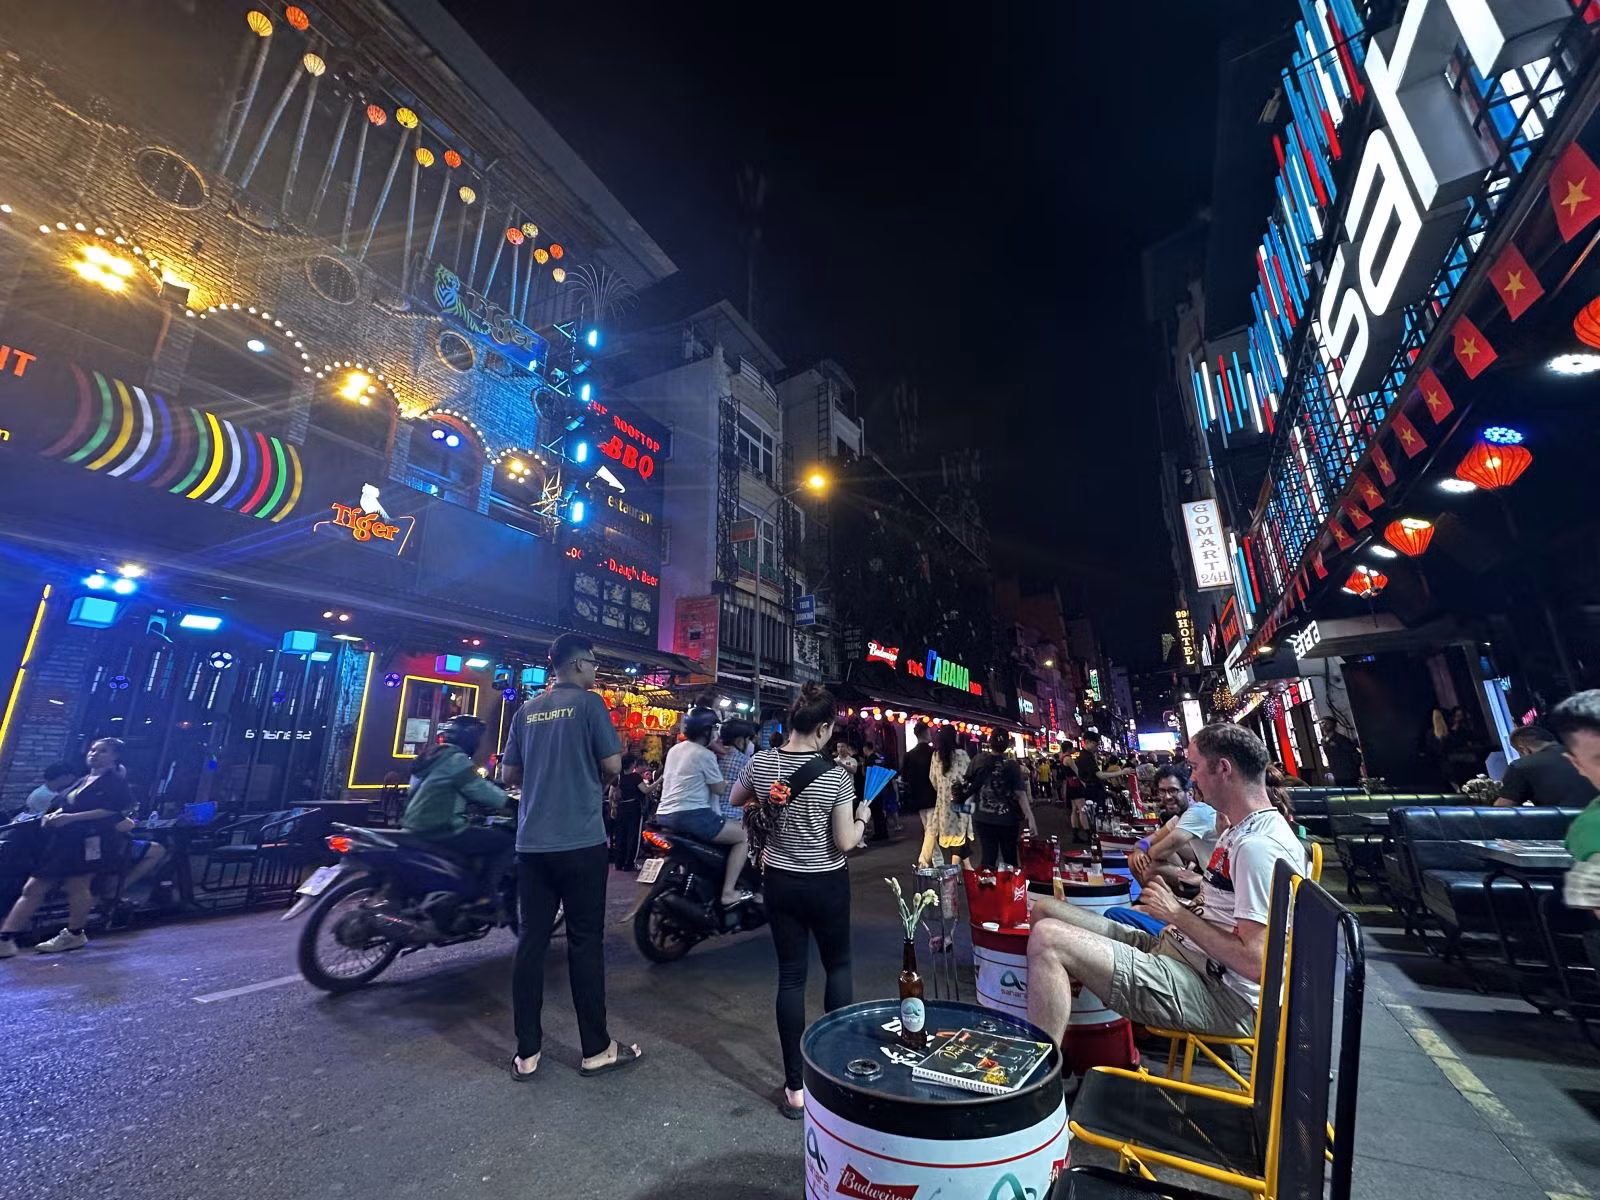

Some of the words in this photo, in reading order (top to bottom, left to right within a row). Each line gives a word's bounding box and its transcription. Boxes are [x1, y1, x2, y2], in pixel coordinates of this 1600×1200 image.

[613, 415, 660, 453] ROOFTOP
[601, 435, 654, 480] BBQ
[331, 502, 400, 541] Tiger
[1191, 503, 1220, 571] GOMART
[1201, 571, 1229, 584] 24H
[1177, 619, 1195, 665] HOTEL
[925, 649, 970, 692] CABANA
[526, 707, 574, 724] SECURITY
